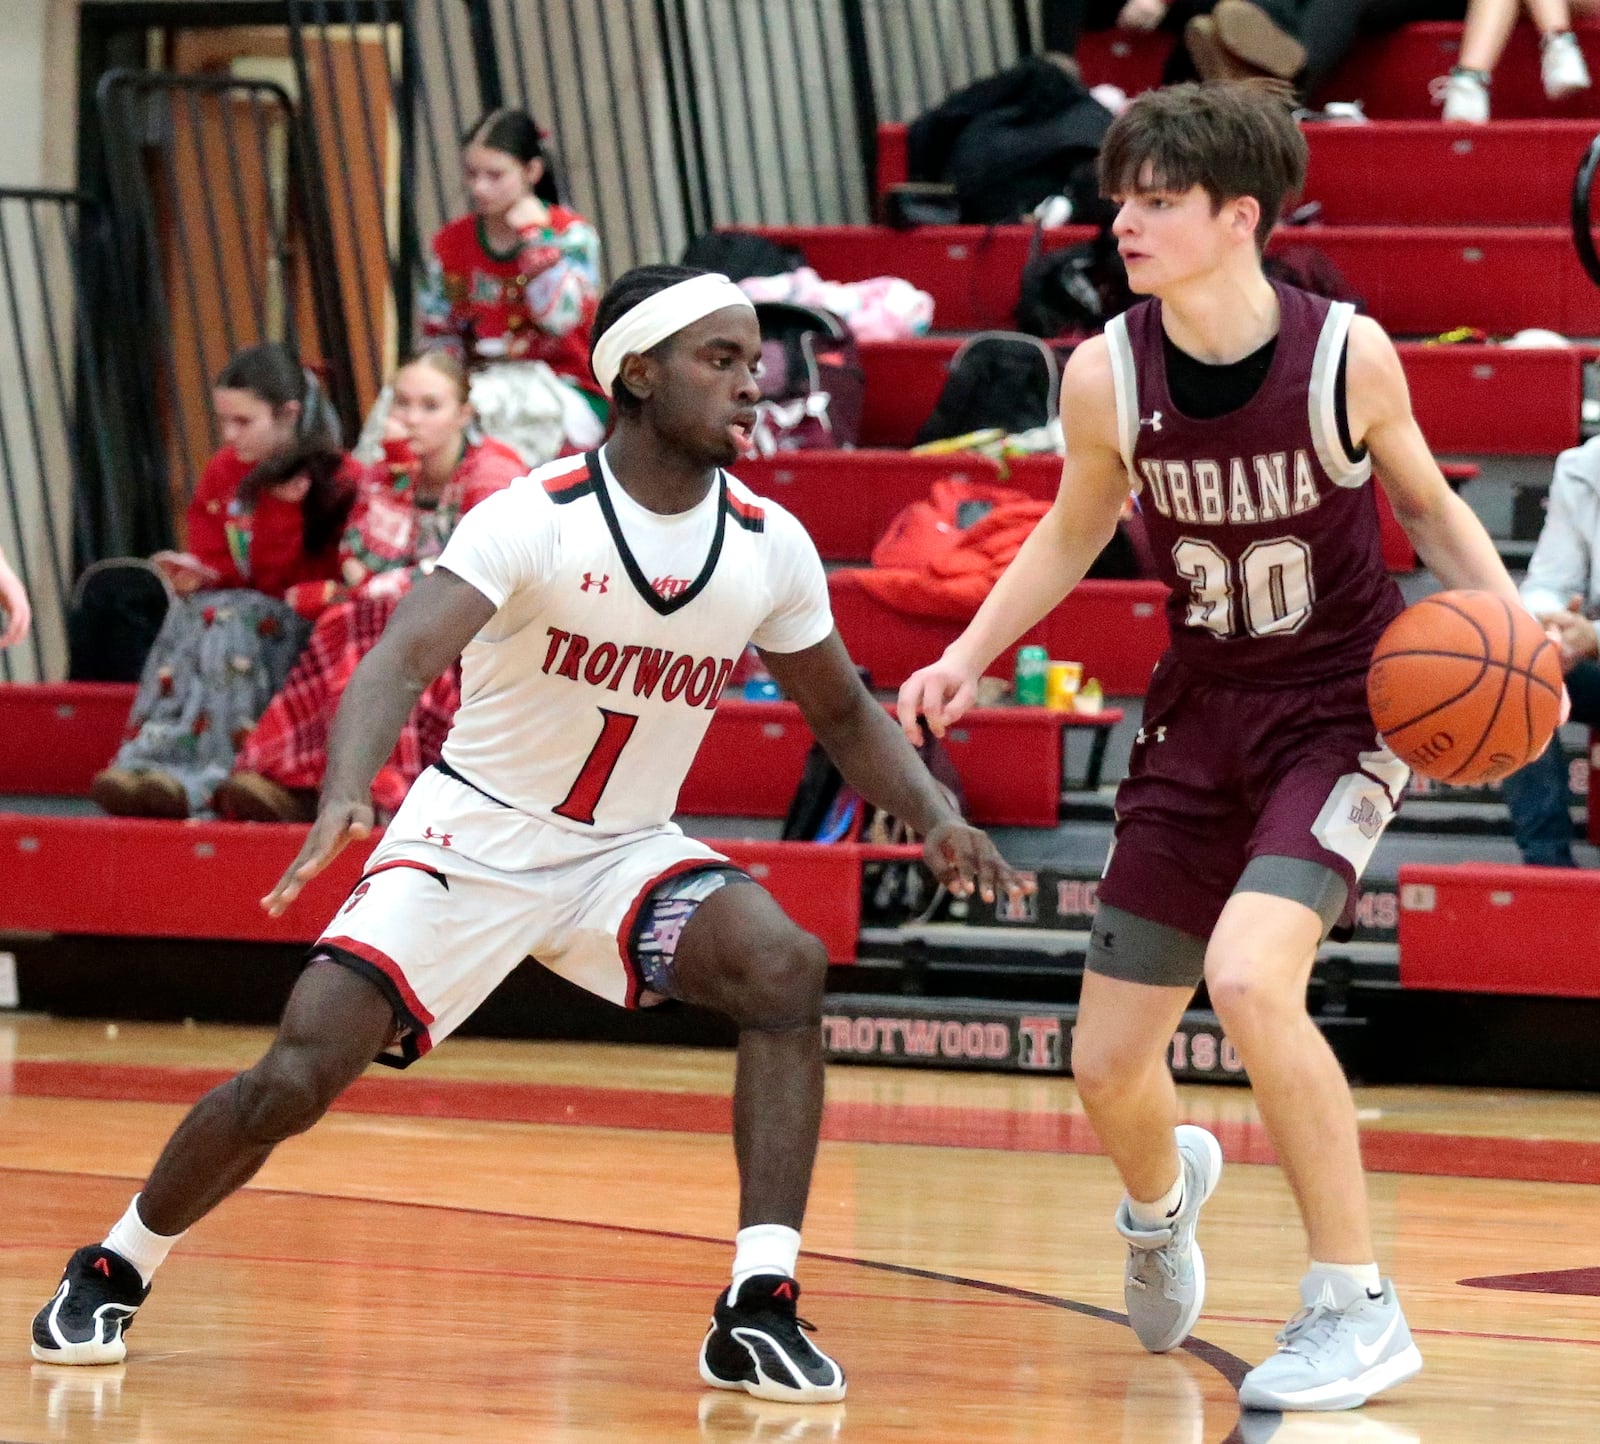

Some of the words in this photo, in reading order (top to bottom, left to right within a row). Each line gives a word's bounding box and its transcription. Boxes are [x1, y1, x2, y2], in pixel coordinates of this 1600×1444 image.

[1139, 449, 1321, 525] URBANA
[1171, 535, 1316, 642] 30
[551, 705, 640, 826] 1
